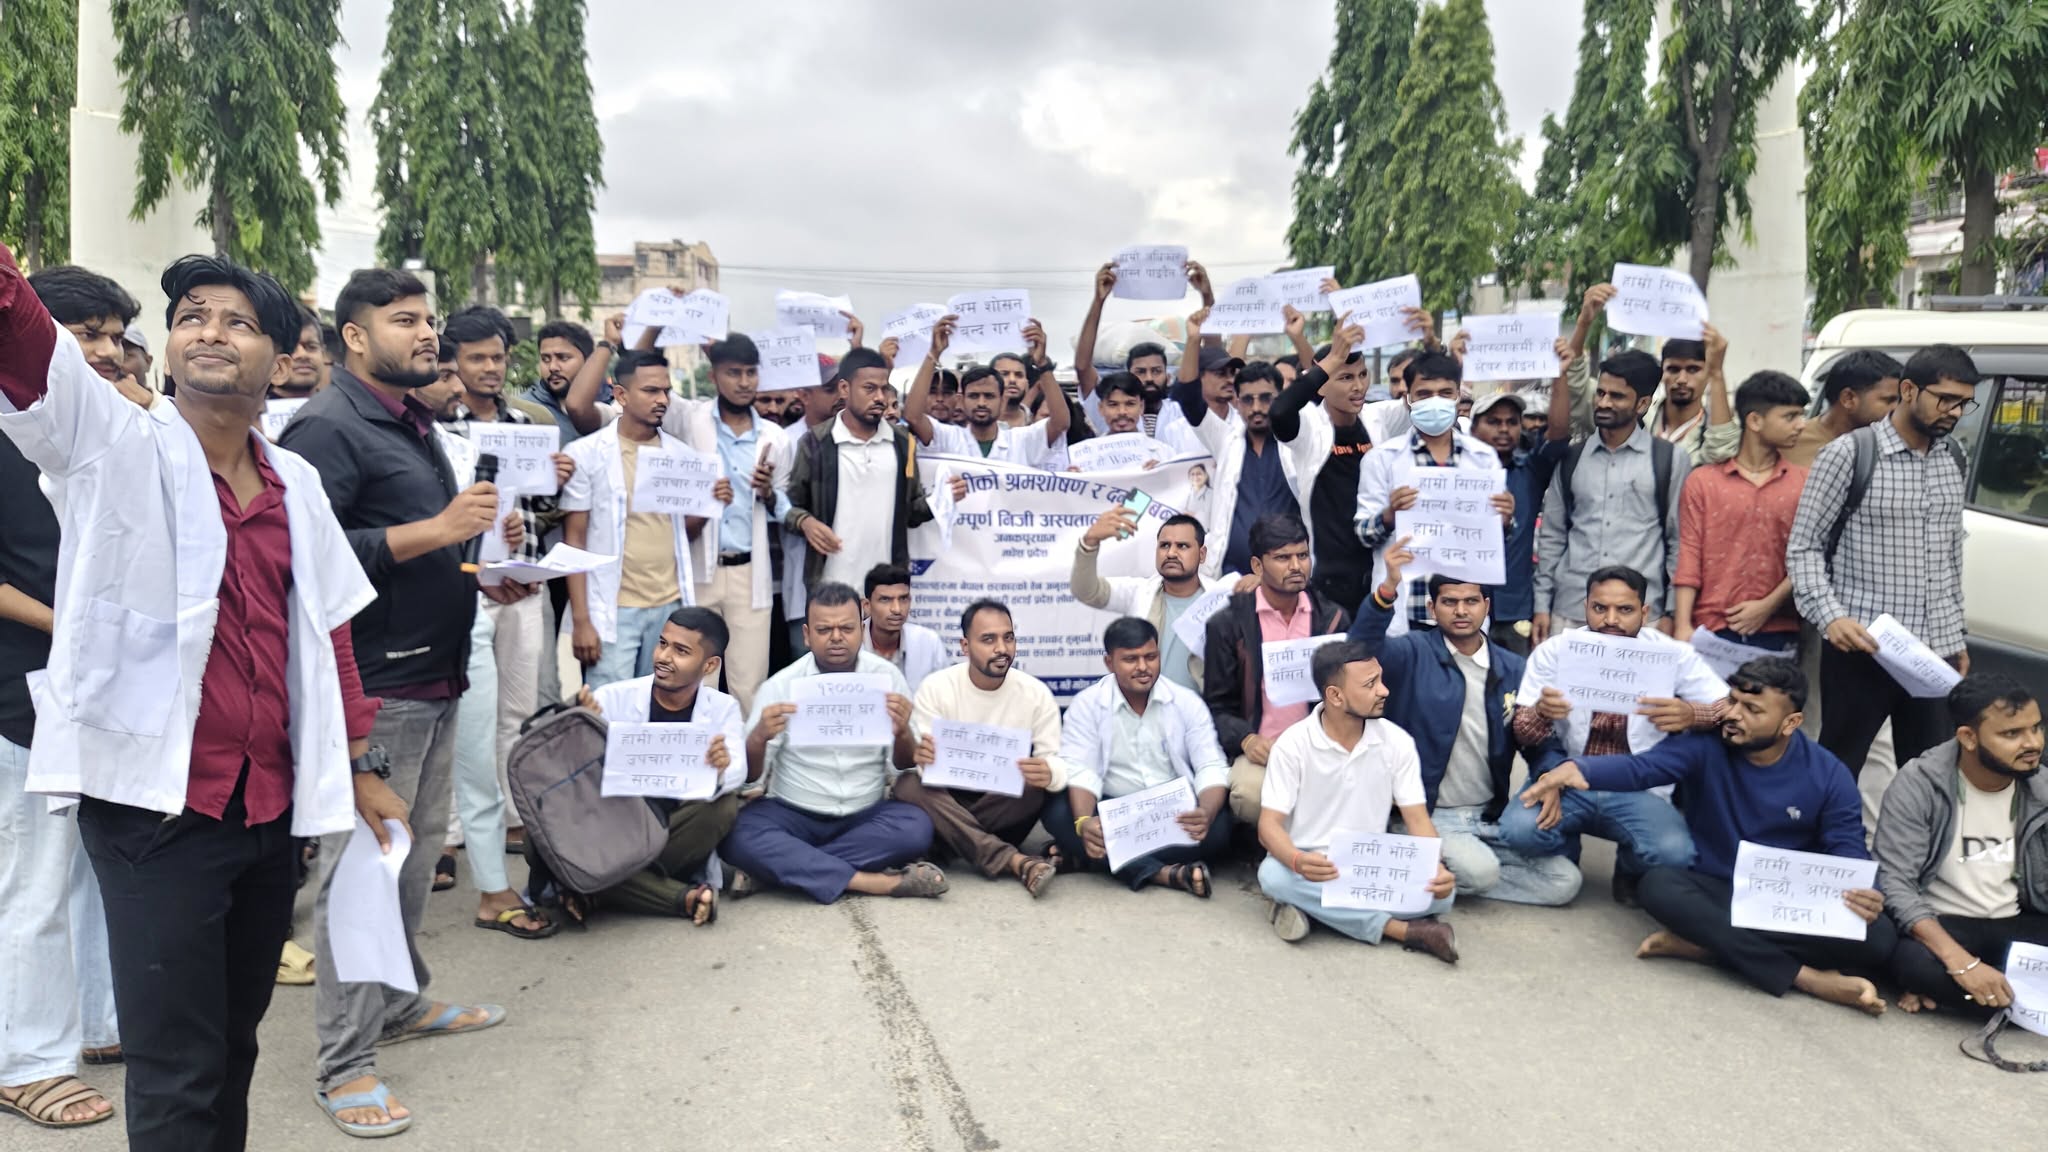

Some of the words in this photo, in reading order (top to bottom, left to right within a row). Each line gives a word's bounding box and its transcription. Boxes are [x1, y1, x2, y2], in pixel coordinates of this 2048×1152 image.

[1108, 453, 1143, 466] Waste
[955, 510, 992, 530] म्पूर्ण
[998, 509, 1034, 527] निजी
[817, 682, 865, 697] १२०००
[620, 729, 653, 745] हामी
[659, 729, 689, 745] रोगी
[625, 753, 673, 766] उपचार
[680, 754, 701, 767] गर
[631, 774, 678, 789] सरकार
[1352, 839, 1383, 856] हामी
[1352, 864, 1382, 879] काम
[1800, 863, 1857, 880] उपचार
